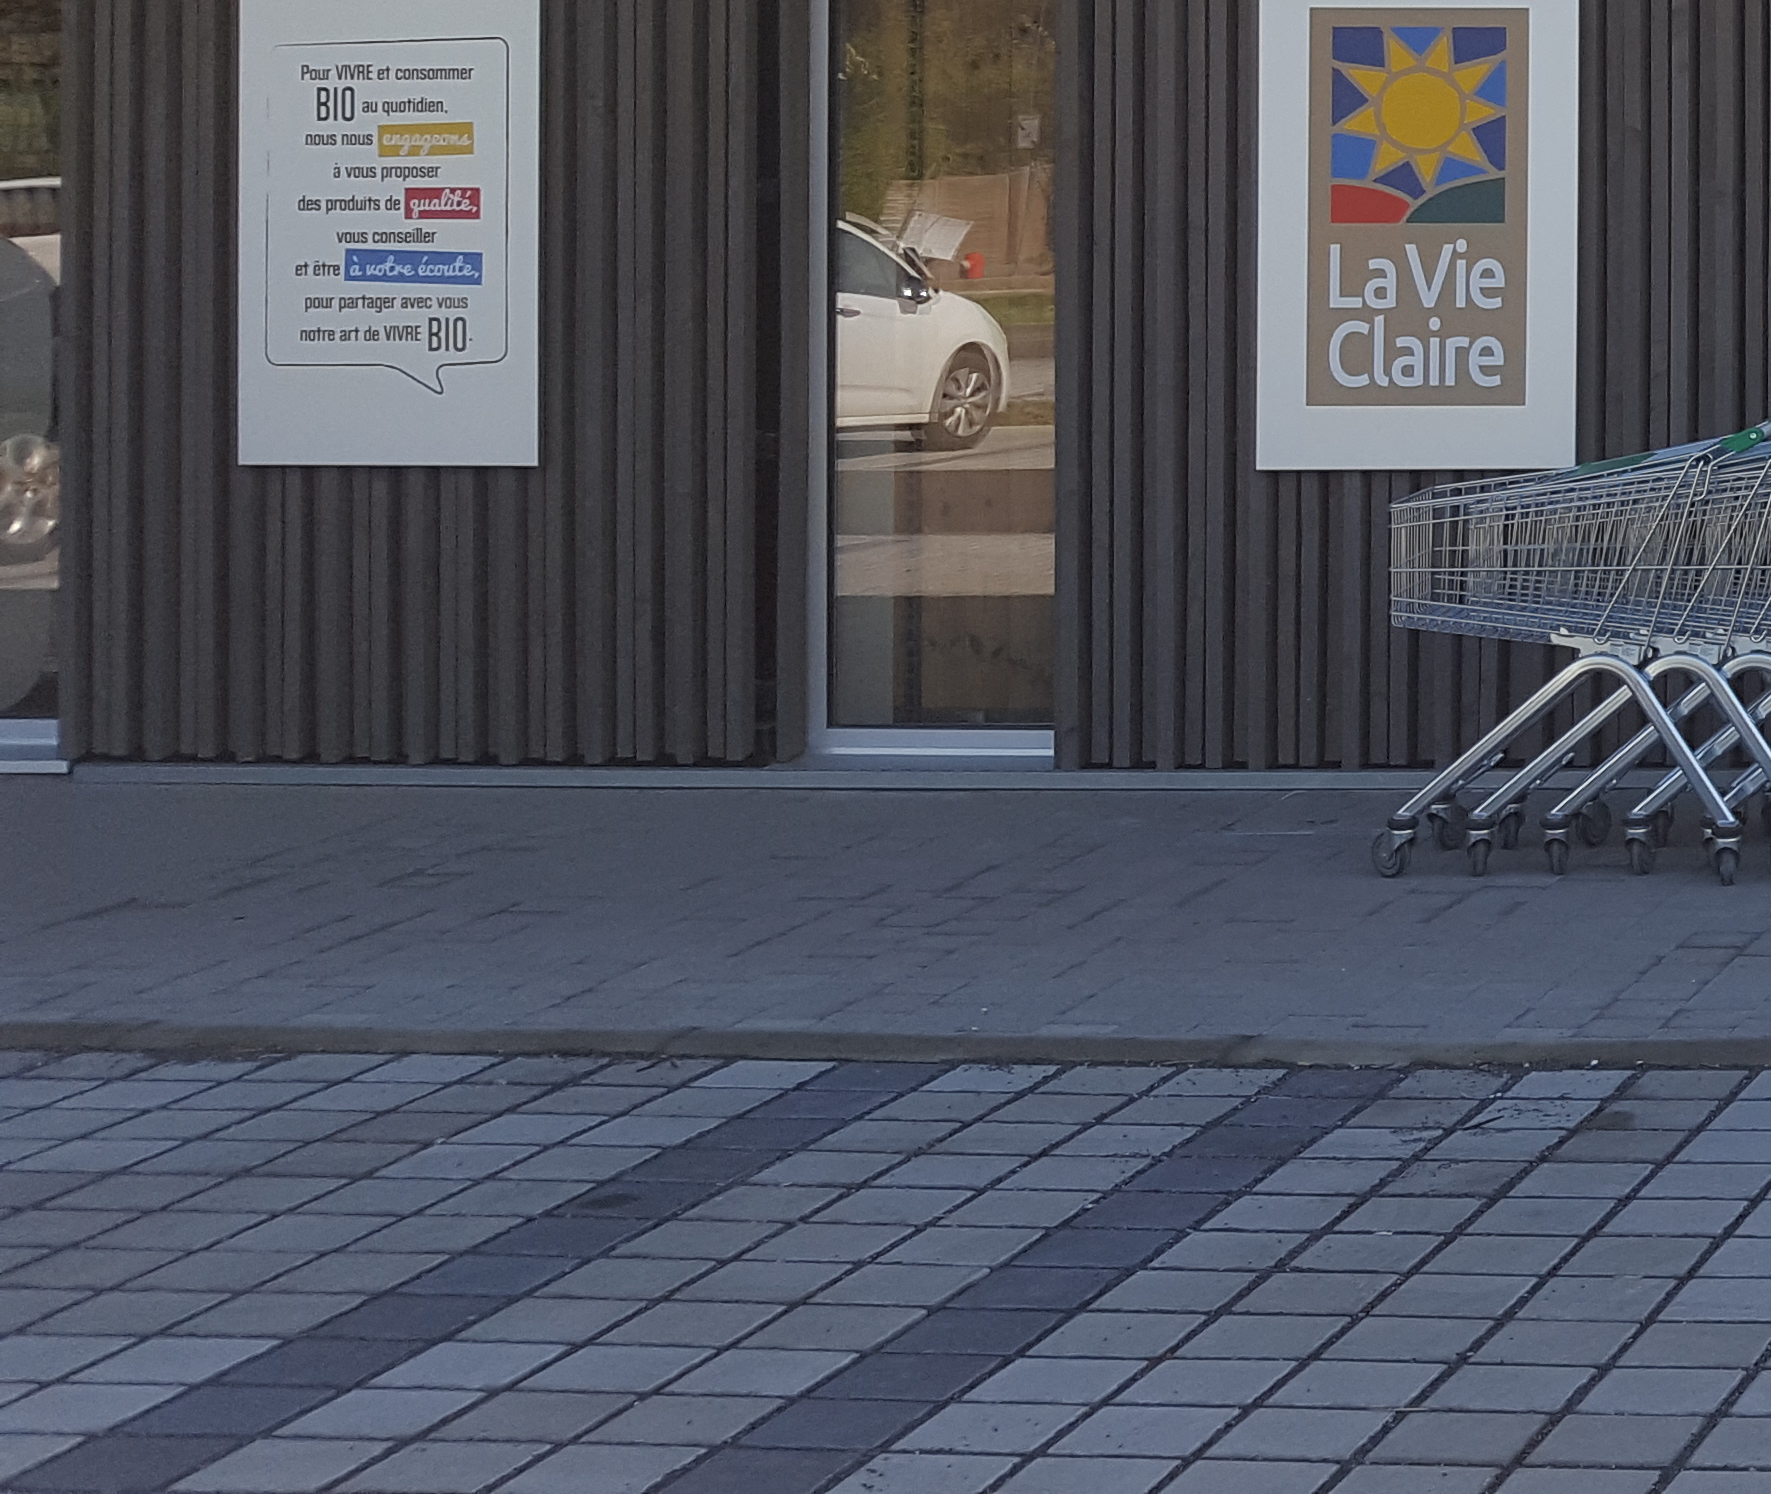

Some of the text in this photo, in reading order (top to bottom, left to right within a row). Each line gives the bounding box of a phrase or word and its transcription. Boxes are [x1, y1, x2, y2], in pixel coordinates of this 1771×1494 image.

[301, 64, 474, 81] Pour VIVRE et consommer
[315, 86, 448, 123] BIO au quotidien,
[305, 130, 472, 155] nous nous engageons
[333, 163, 440, 183] à vous proposer
[298, 189, 478, 217] des produits de qualité,
[336, 227, 436, 244] vous conseiller
[295, 257, 480, 280] et être à votre écoute,
[1329, 238, 1505, 309] La Vie
[305, 294, 468, 313] pour partager avec vous
[300, 327, 335, 343] notre
[340, 327, 359, 342] art
[364, 325, 380, 342] de
[384, 325, 421, 342] VIVRE
[1329, 314, 1505, 388] Claire
